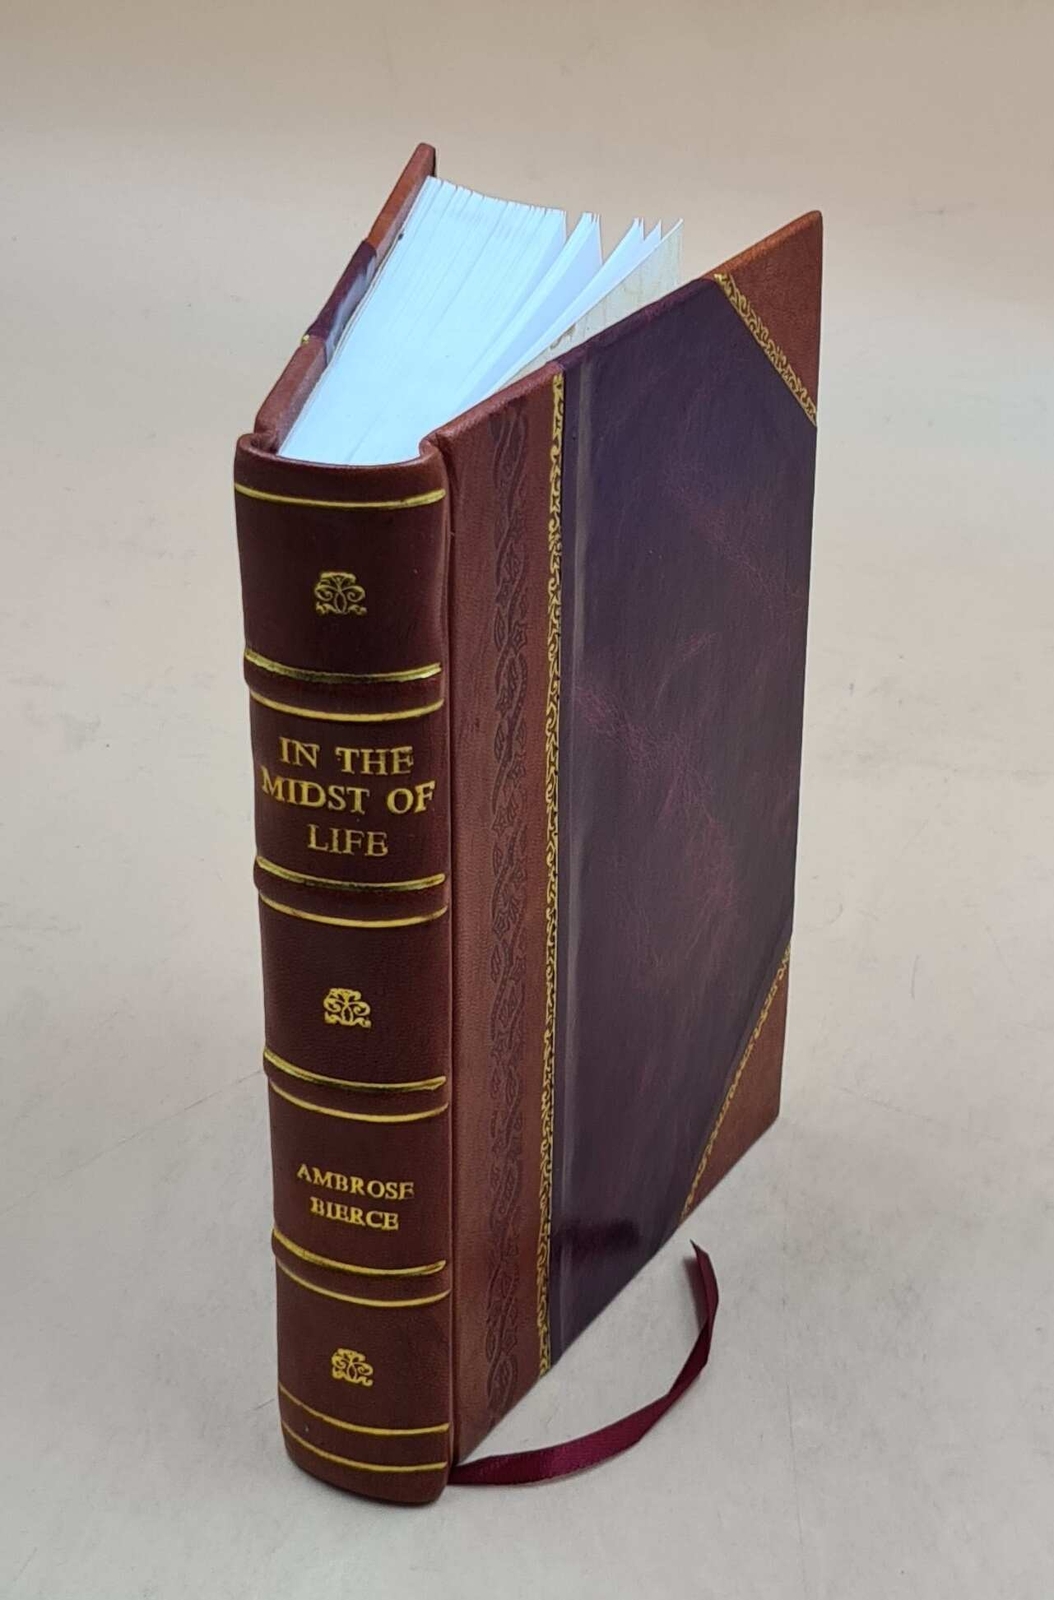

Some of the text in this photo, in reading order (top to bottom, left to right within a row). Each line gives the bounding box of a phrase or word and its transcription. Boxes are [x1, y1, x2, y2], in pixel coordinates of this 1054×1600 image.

[279, 736, 414, 776] IN THE
[260, 765, 436, 815] MIDST OF
[307, 824, 388, 857] LIFE
[296, 1163, 415, 1200] AMBROSE
[310, 1196, 399, 1230] BIERCE
